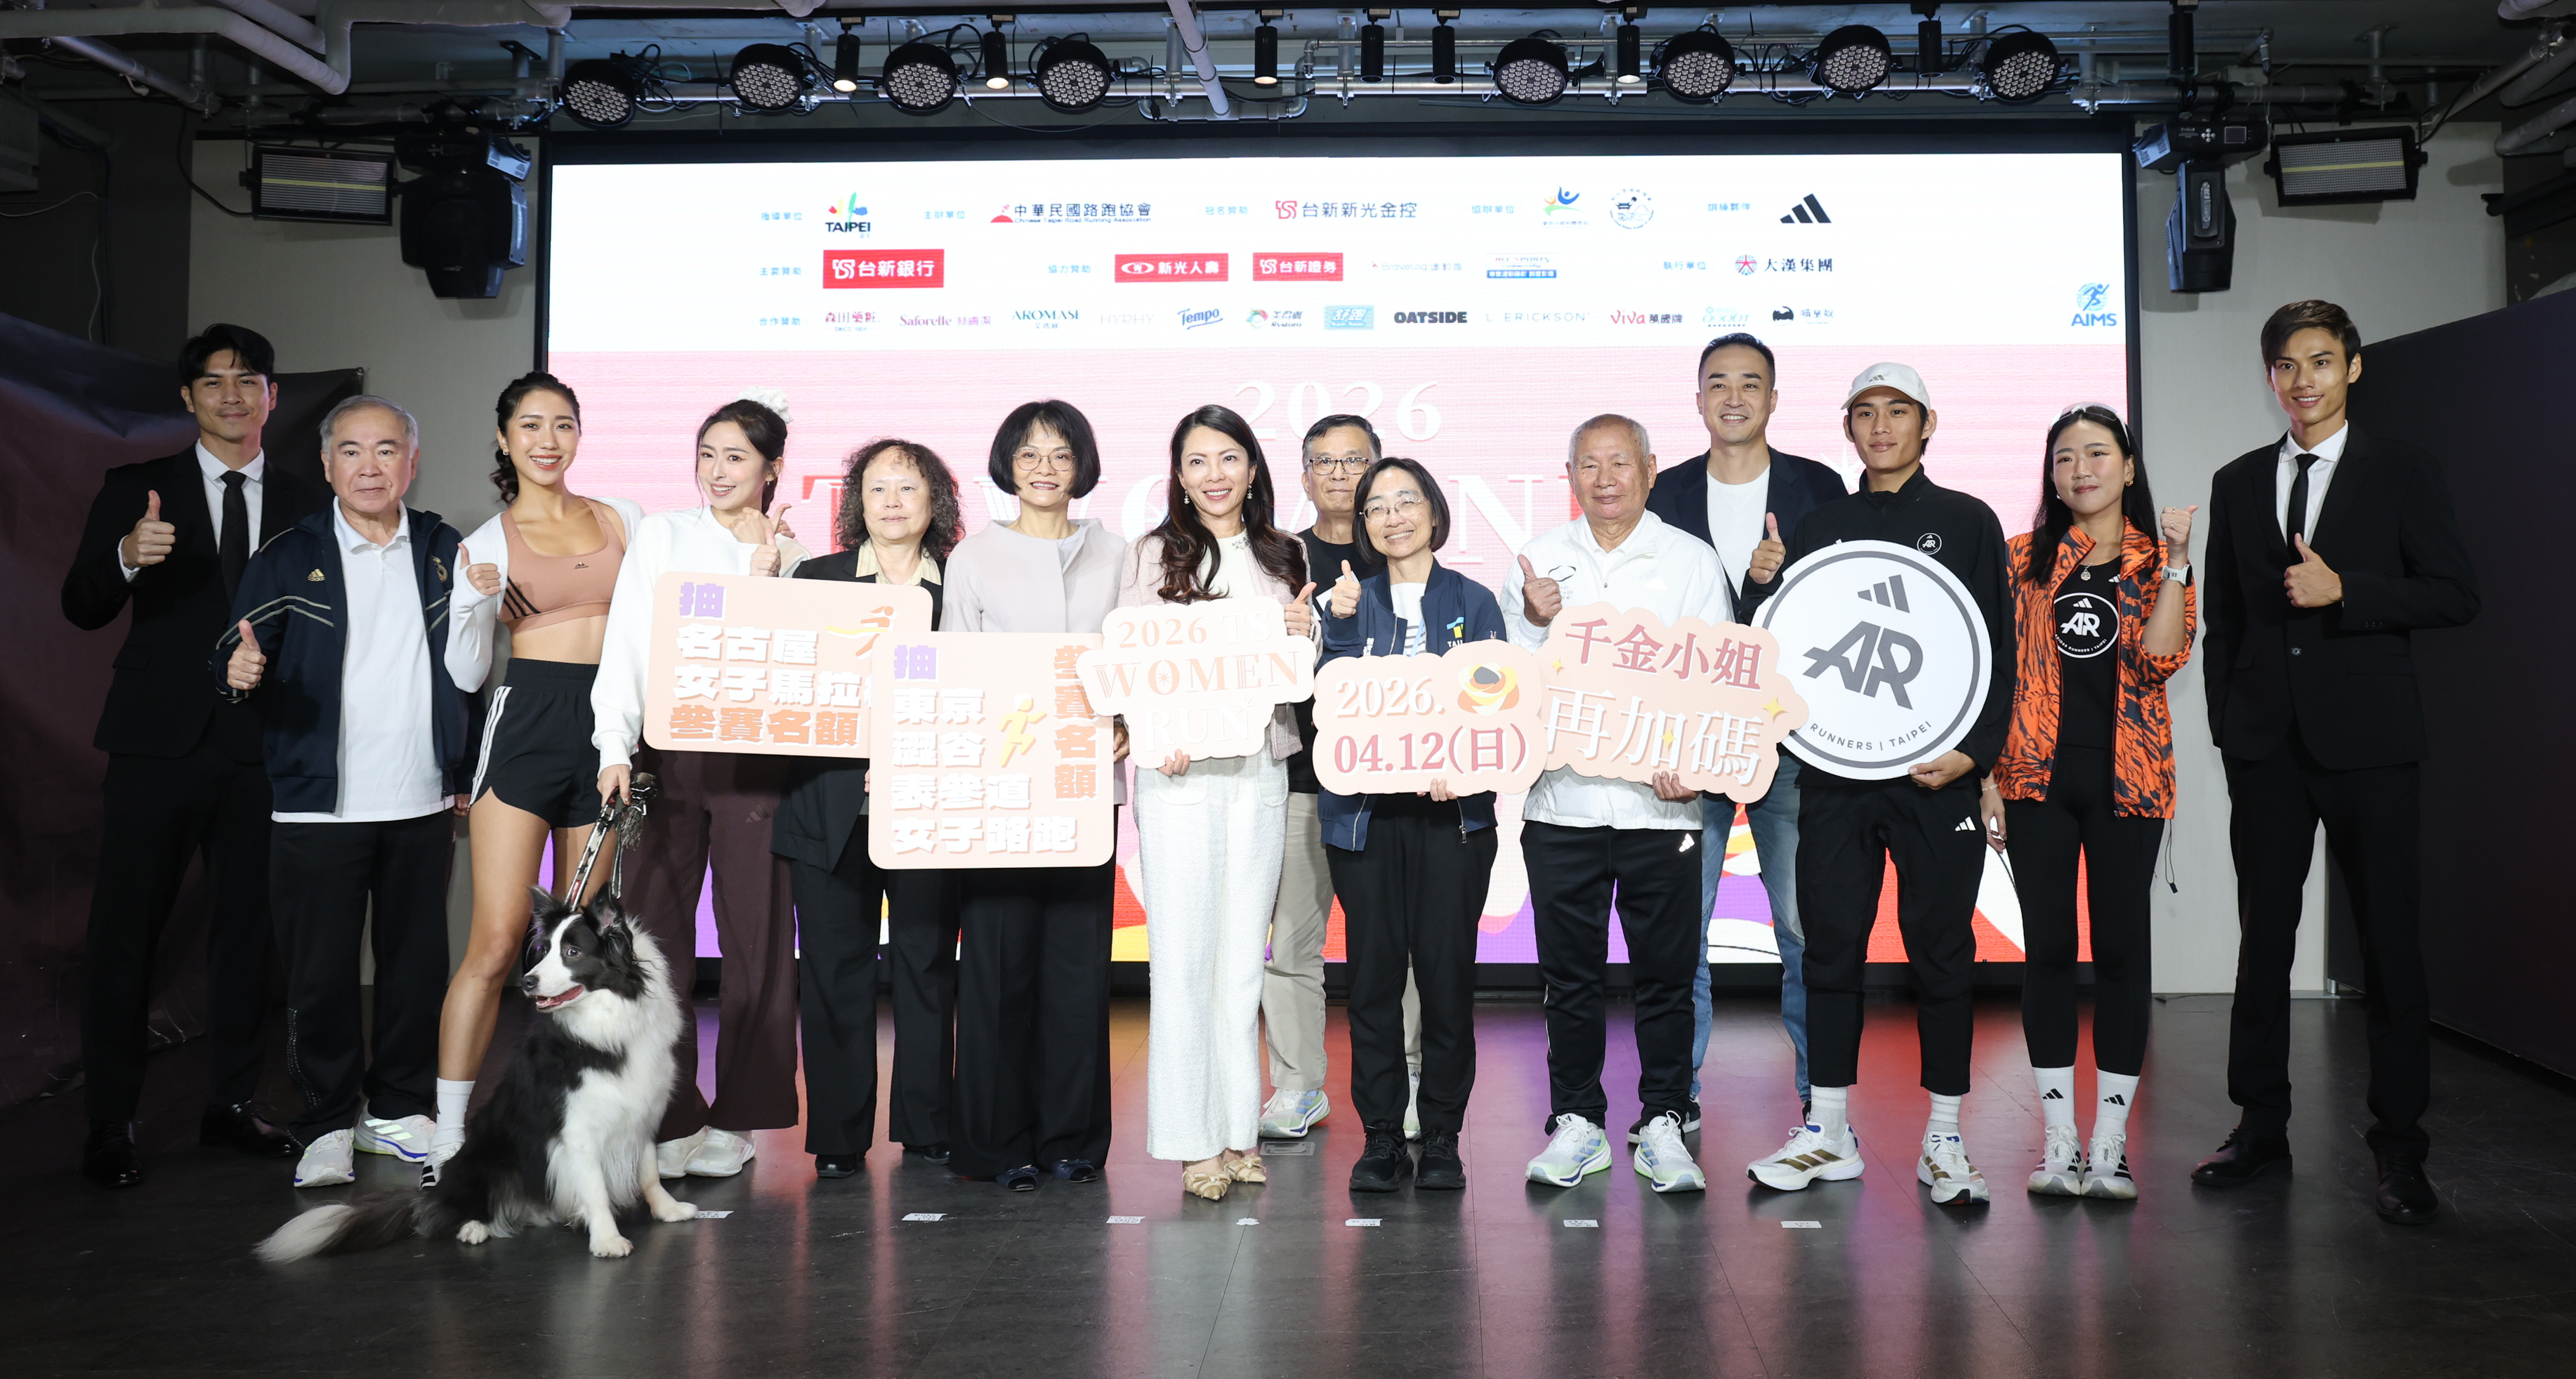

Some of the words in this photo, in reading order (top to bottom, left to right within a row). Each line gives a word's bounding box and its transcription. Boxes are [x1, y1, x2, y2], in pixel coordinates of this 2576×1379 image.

[824, 221, 871, 233] TAIPEI
[1013, 202, 1152, 218] 中華民國路跑協會
[1301, 202, 1417, 218] 台新新光金控
[857, 260, 935, 277] 台新銀行
[1048, 264, 1091, 274] 協力贊助
[1157, 260, 1220, 275] 新光人壽
[1279, 260, 1337, 274] 台新證券
[1765, 258, 1833, 272] 大漢集團
[899, 315, 952, 326] Saforelle
[1177, 308, 1221, 326] Tempo
[1393, 311, 1468, 324] OATSIDE
[2070, 313, 2118, 326] AIMS
[1234, 381, 1442, 442] 2026
[678, 581, 728, 621] 抽
[676, 622, 820, 666] 名古屋
[1118, 616, 1207, 649] 2026
[1218, 610, 1272, 645] TS
[893, 644, 940, 681] 抽
[1565, 617, 1764, 692] 千金小姐
[1092, 650, 1301, 699] WOMEN
[891, 687, 986, 725] 東京
[1333, 674, 1443, 719] 2026.
[1141, 704, 1252, 753] RUN
[1544, 682, 1765, 787] 再加碼
[1810, 723, 1873, 751] RUNNERS
[1888, 720, 1932, 747] TAIPEI
[1333, 723, 1530, 777] 04.12(日)
[890, 815, 1078, 855] 女子路跑
